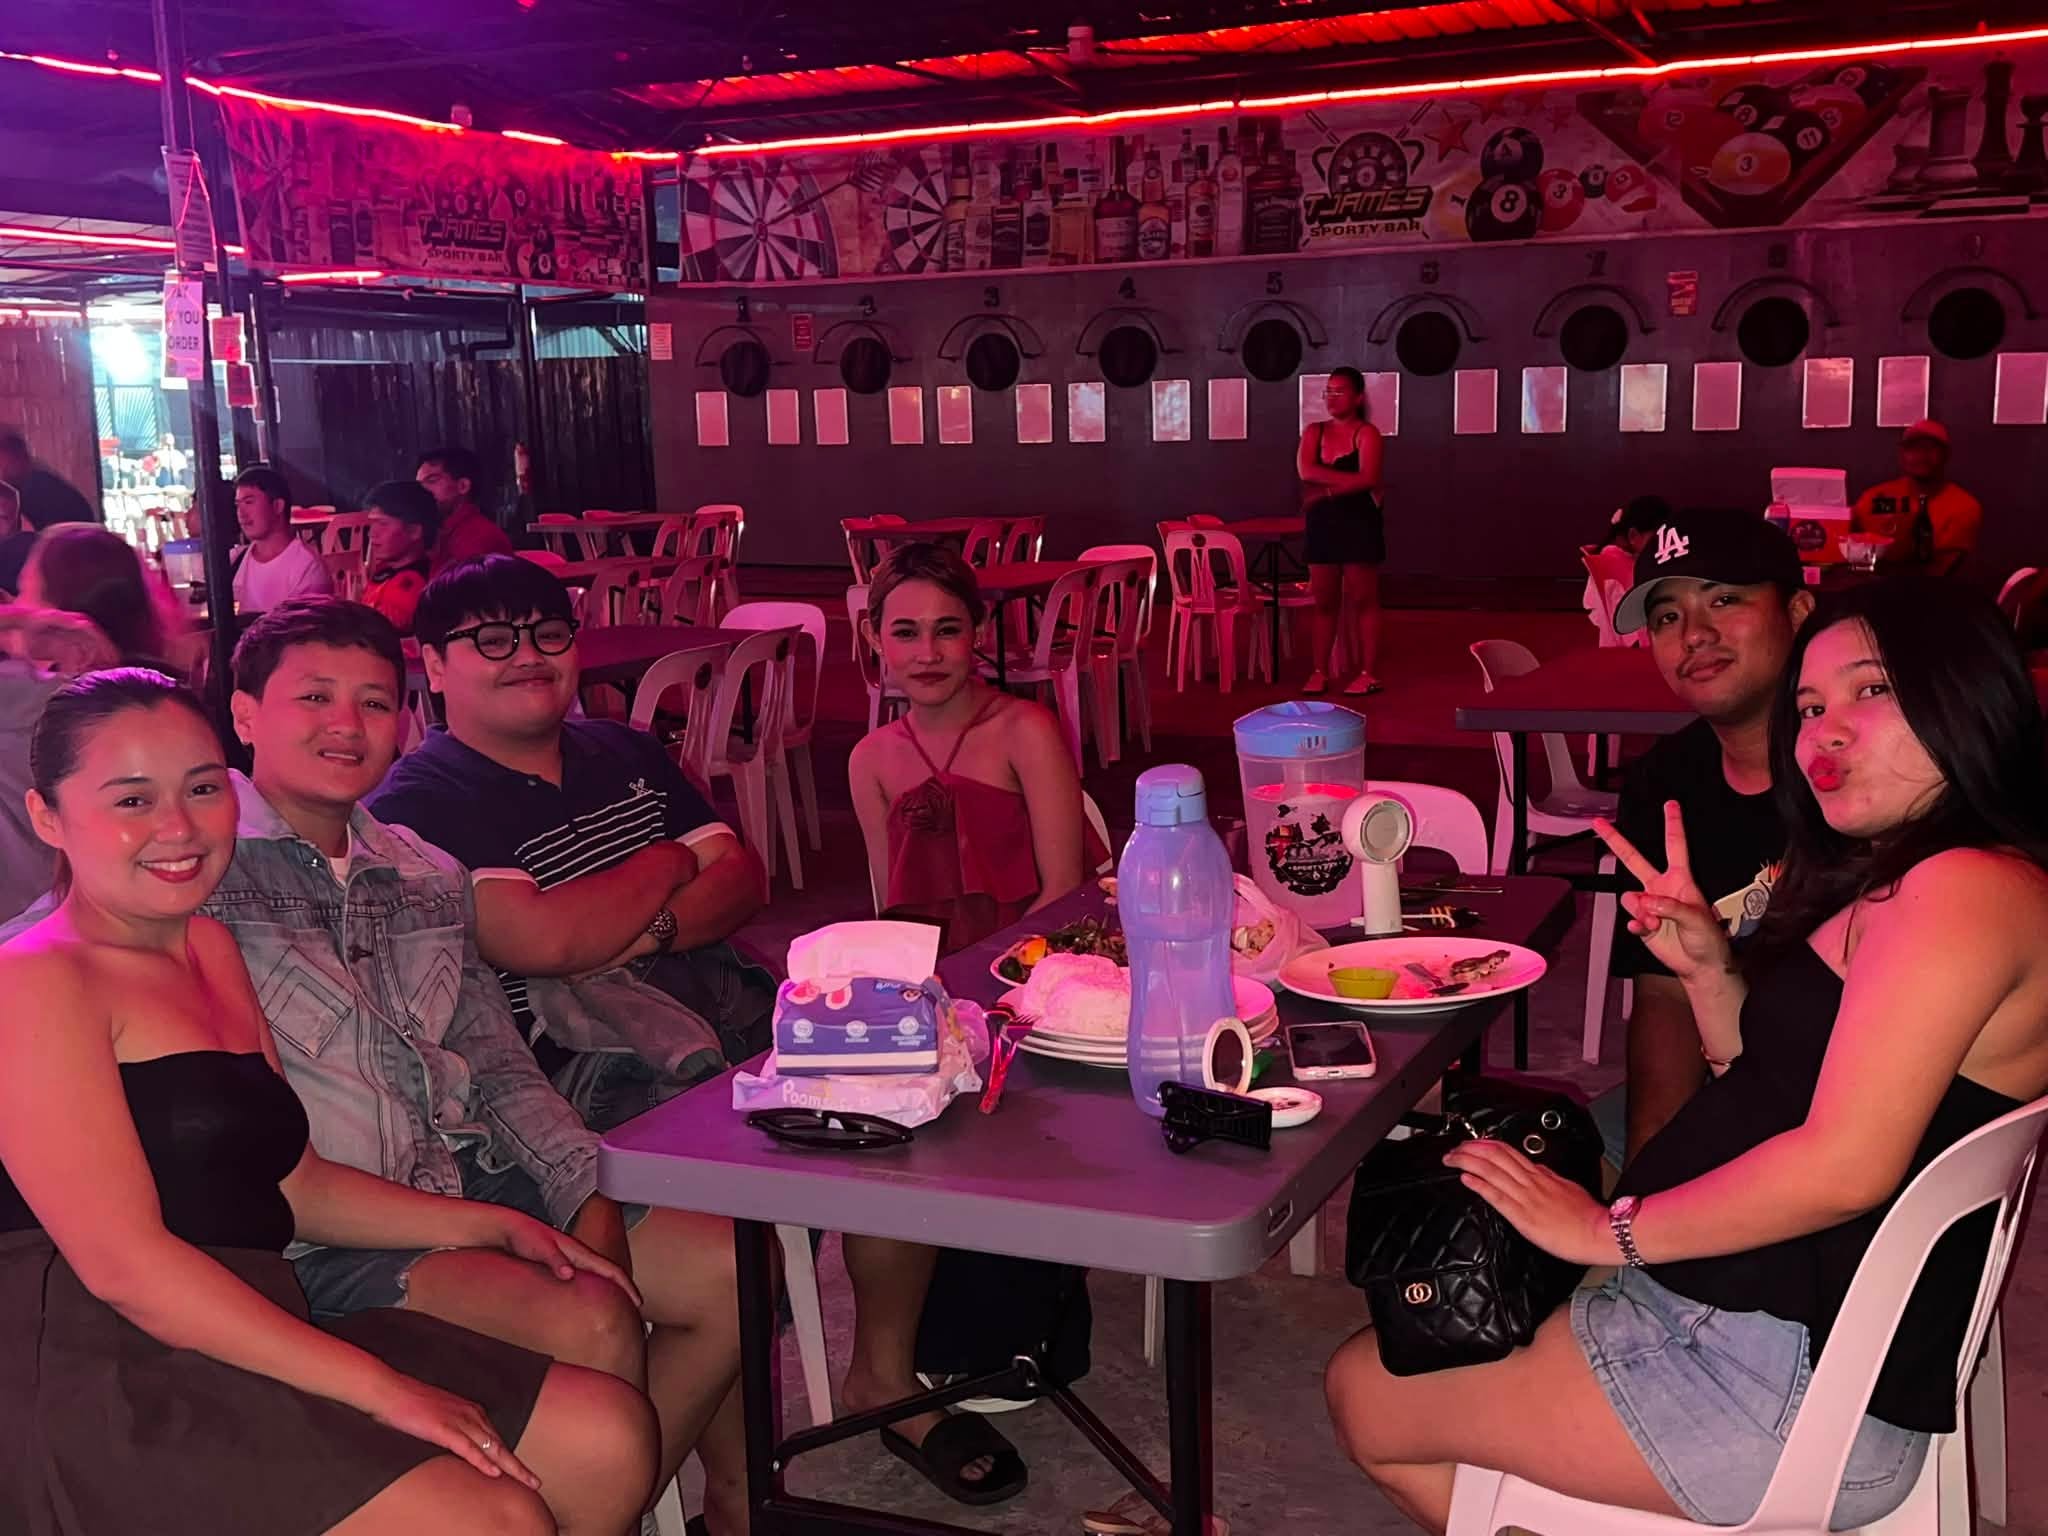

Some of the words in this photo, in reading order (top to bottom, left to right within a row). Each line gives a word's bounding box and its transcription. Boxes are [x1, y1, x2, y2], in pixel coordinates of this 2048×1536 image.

[1499, 189, 1520, 213] 8
[1310, 224, 1382, 238] SPORTY
[1118, 277, 1136, 298] 4
[1266, 272, 1284, 295] 5
[984, 286, 1001, 308] 3
[178, 311, 200, 325] YOU
[168, 335, 200, 351] ORDER
[1654, 523, 1690, 565] LA
